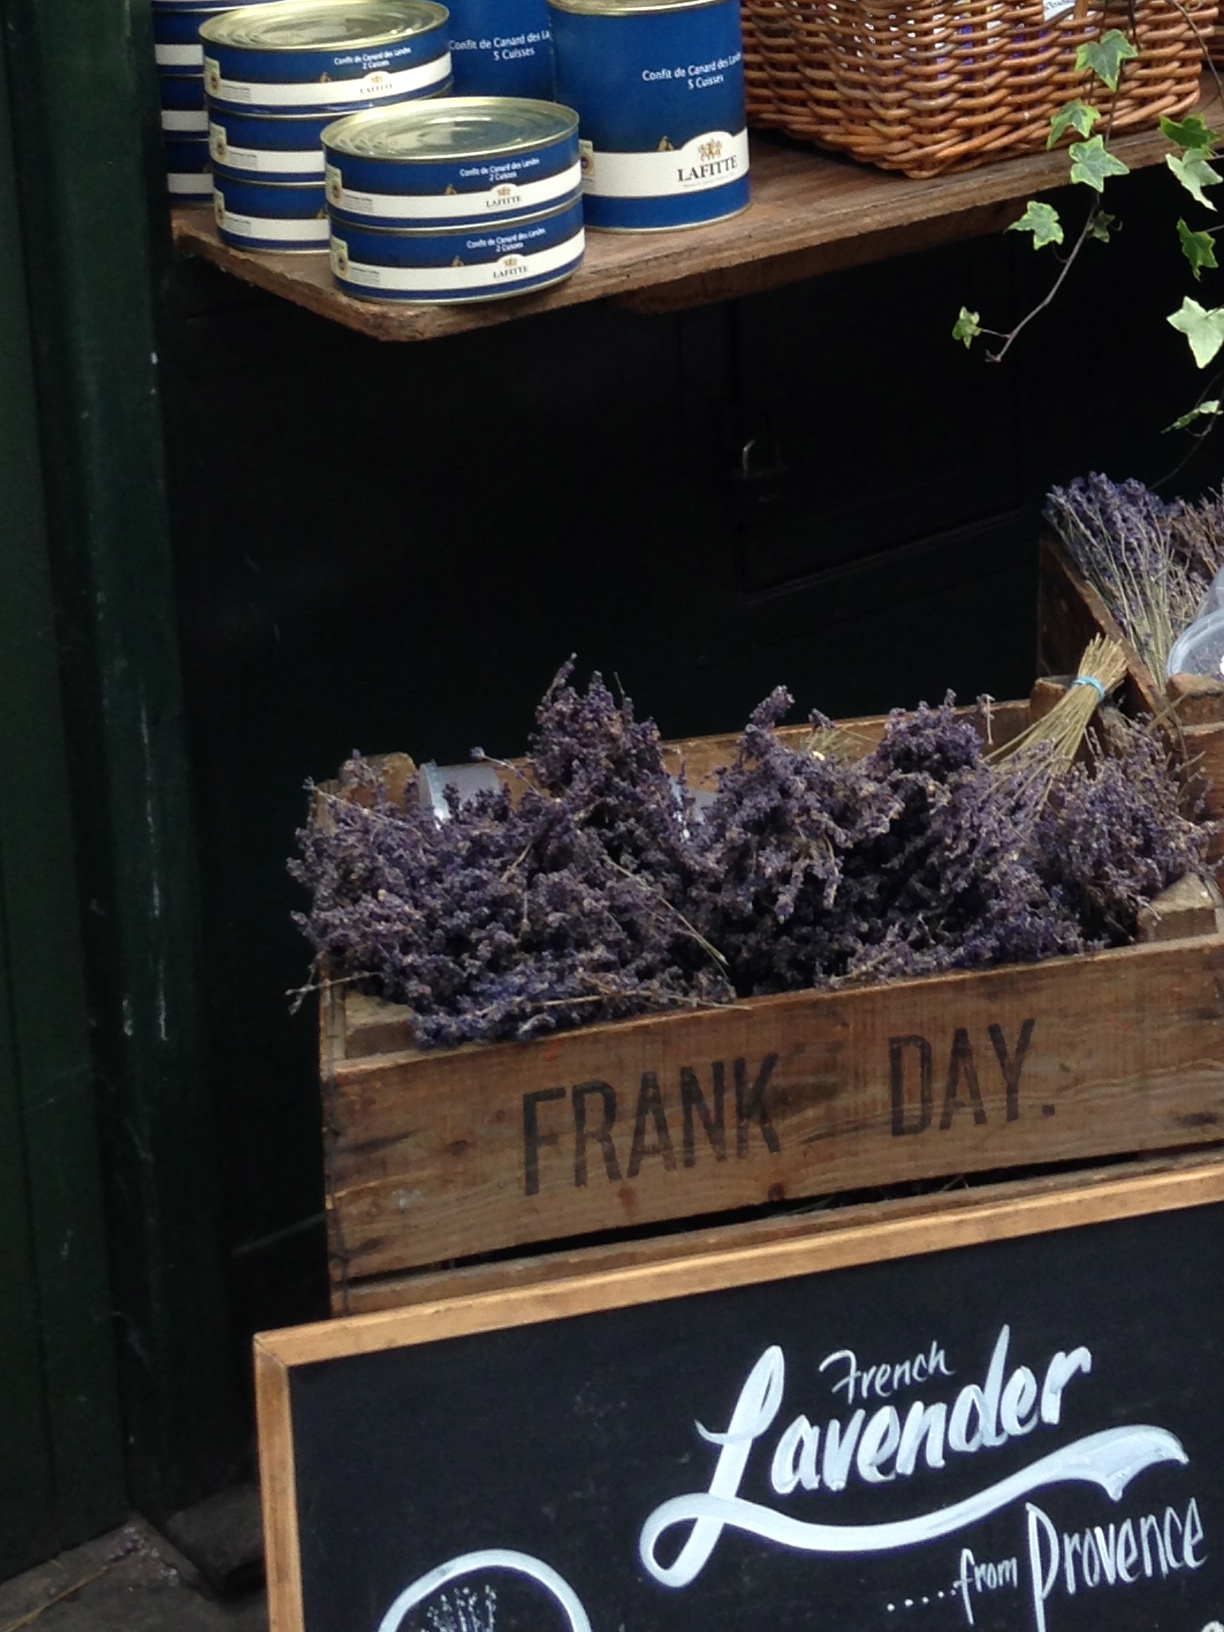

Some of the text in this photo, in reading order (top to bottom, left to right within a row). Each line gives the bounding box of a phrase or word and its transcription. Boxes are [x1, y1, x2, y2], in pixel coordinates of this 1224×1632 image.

[449, 39, 478, 50] Confit
[479, 39, 492, 49] de
[493, 34, 525, 48] Canard
[527, 32, 540, 43] des
[502, 47, 536, 60] Cuisses
[642, 69, 672, 81] Confit
[674, 67, 686, 78] de
[687, 62, 716, 76] Canard
[717, 58, 729, 70] des
[696, 74, 724, 88] Cuisses
[677, 155, 738, 182] LAFITTE
[486, 196, 522, 208] LAFITTE
[493, 266, 528, 279] LAFITTE
[523, 1018, 1057, 1196] FRANK DAY.
[818, 1340, 956, 1404] French
[640, 1325, 1095, 1586] Lavender
[1026, 1497, 1209, 1632] Provence
